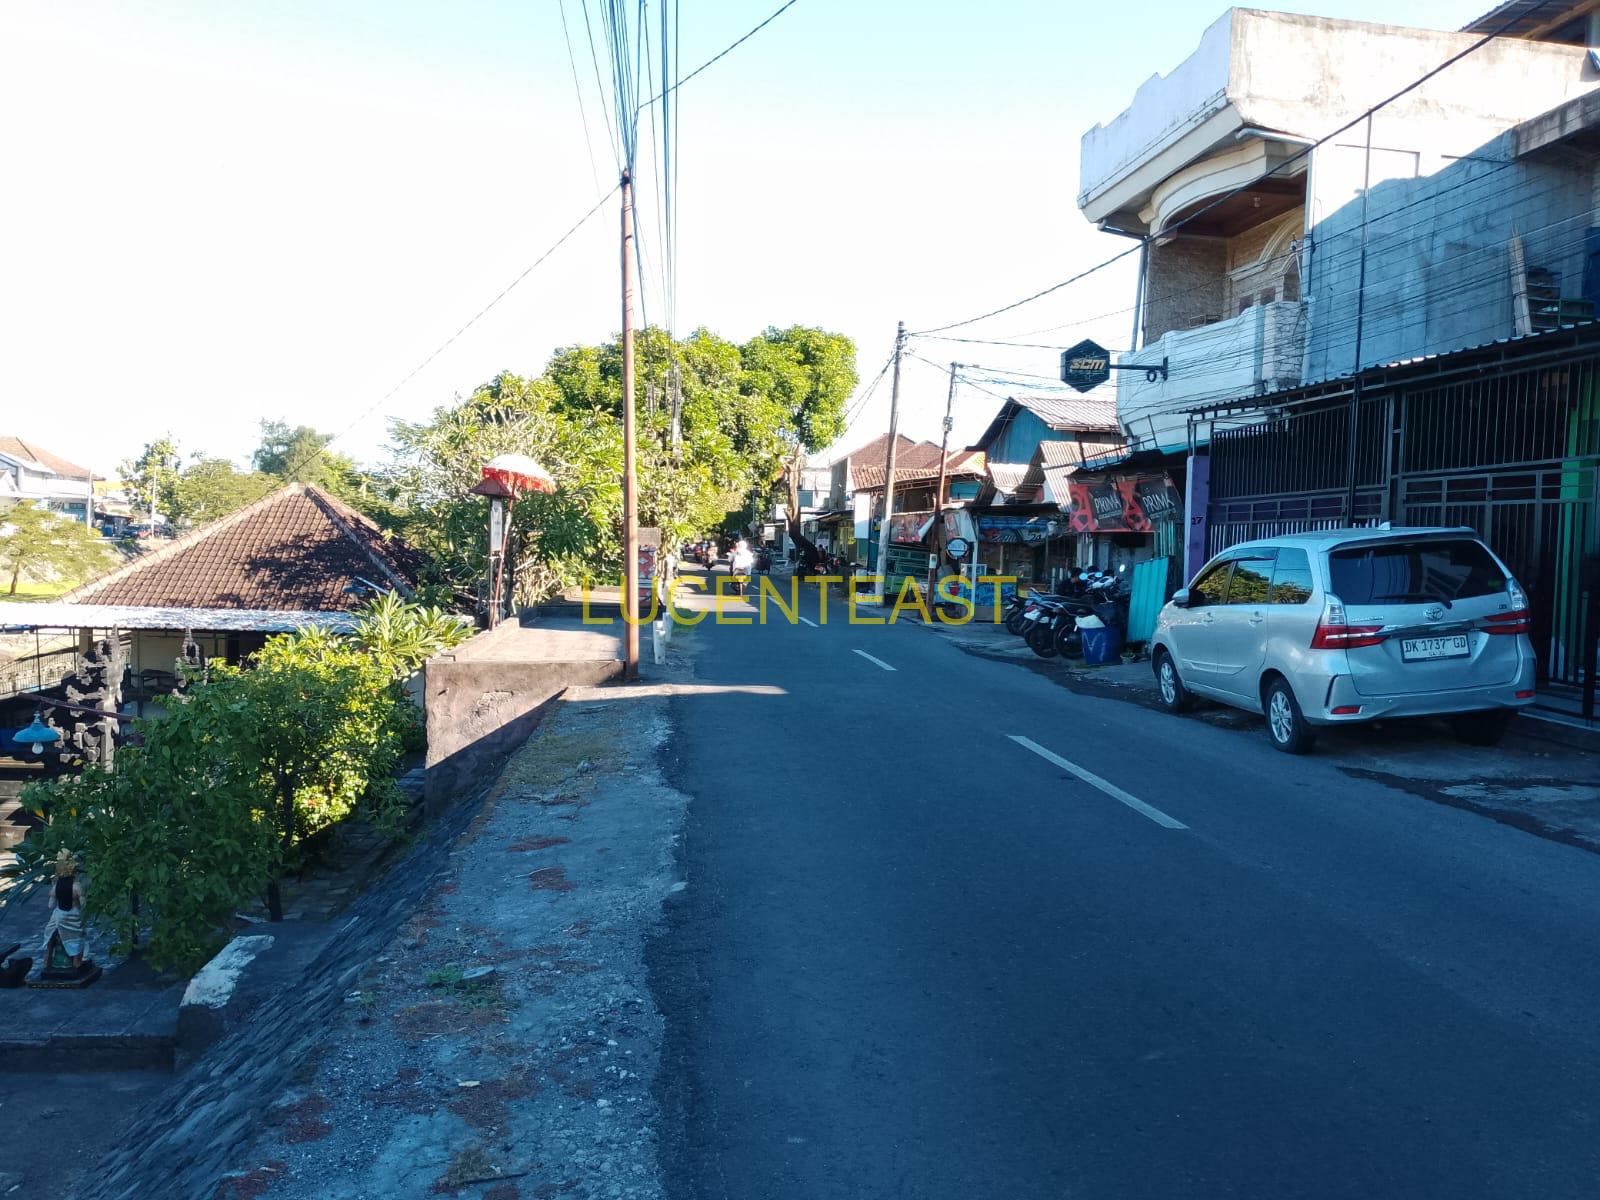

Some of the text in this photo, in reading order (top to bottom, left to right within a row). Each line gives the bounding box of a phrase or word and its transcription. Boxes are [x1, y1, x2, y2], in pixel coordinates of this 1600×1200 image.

[1404, 636, 1466, 653] DK 1737 GD
